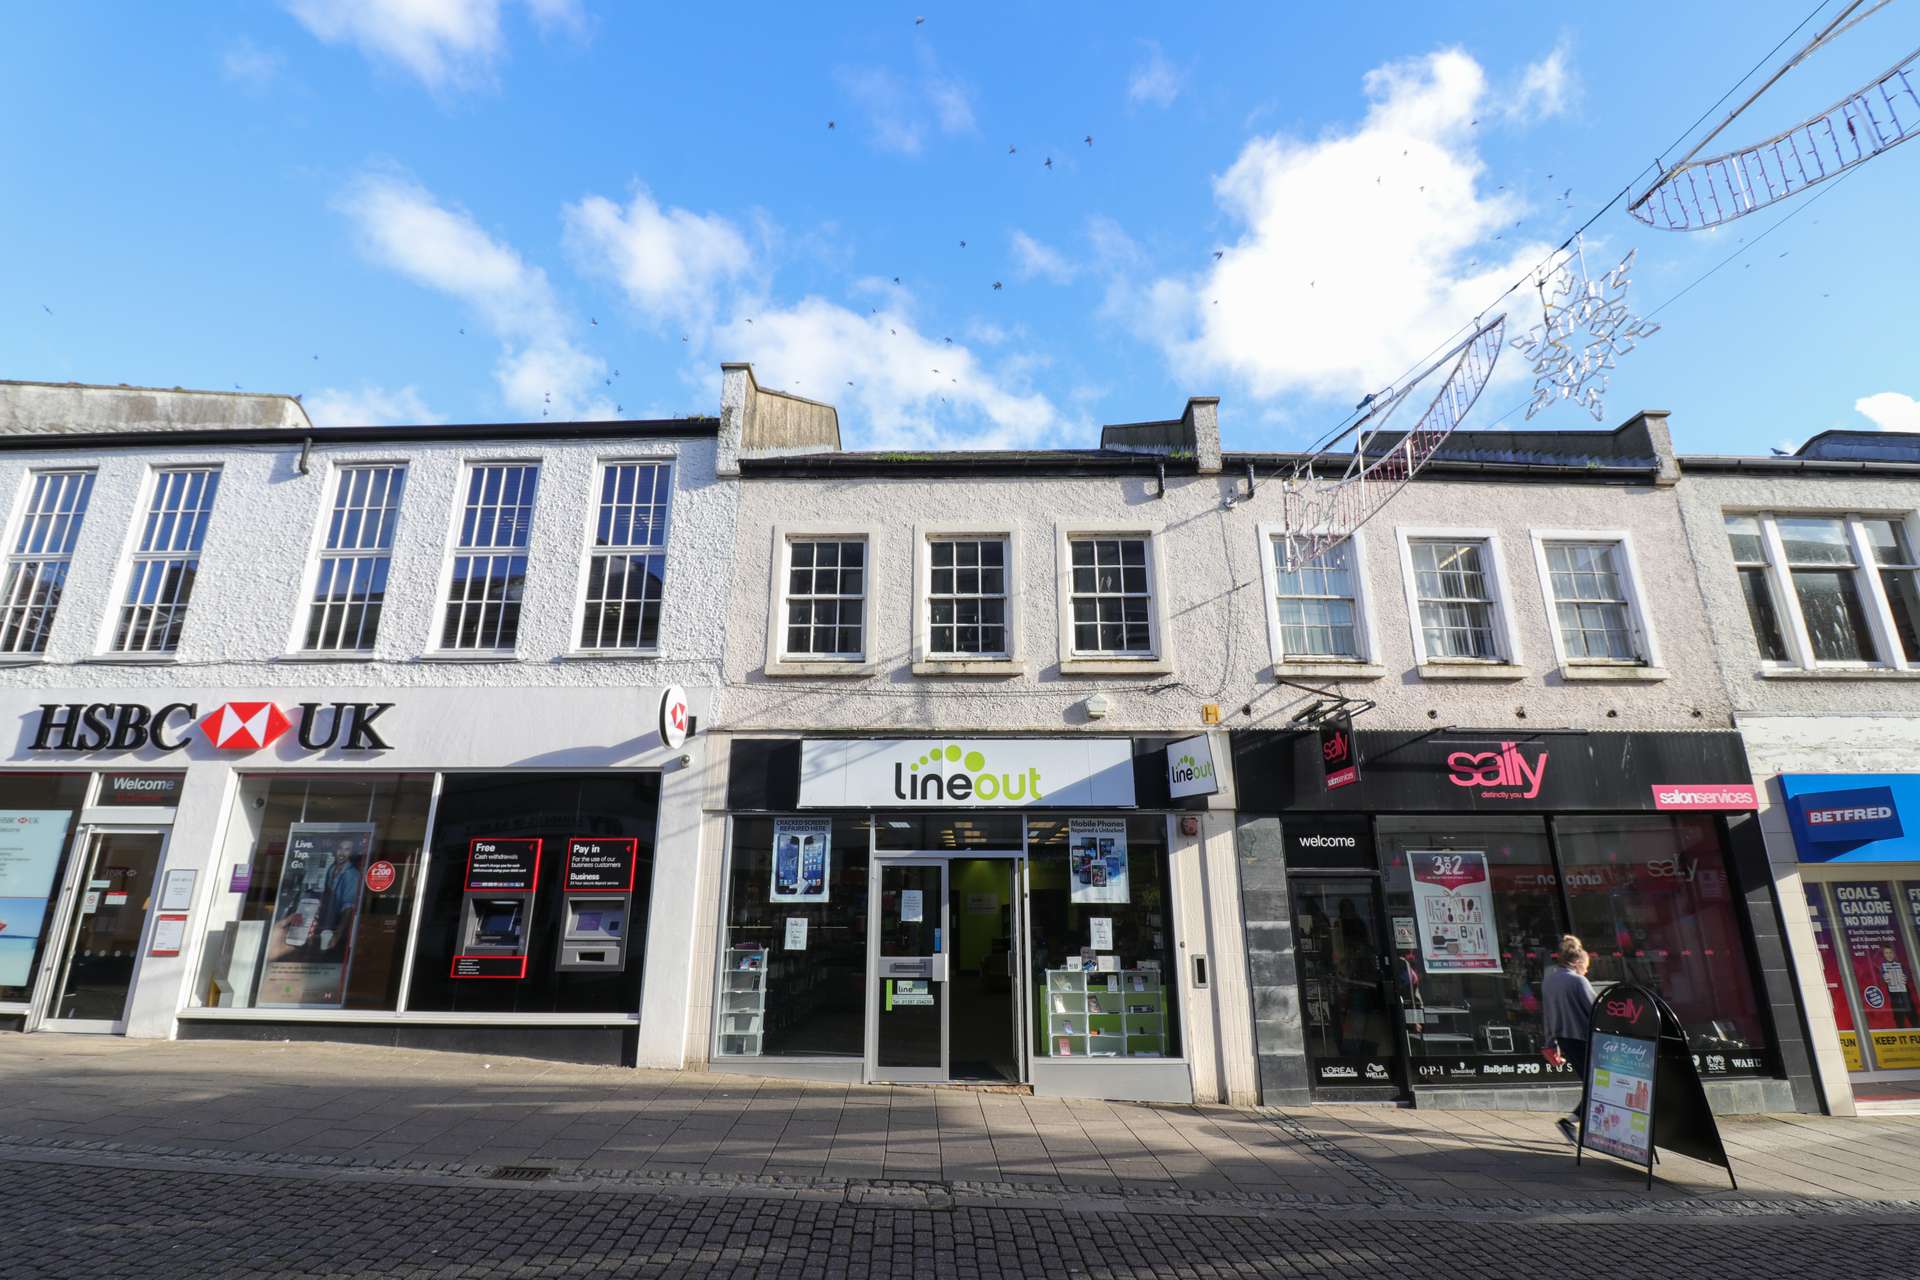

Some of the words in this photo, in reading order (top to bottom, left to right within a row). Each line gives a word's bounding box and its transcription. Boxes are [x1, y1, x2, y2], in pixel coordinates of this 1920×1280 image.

[27, 703, 198, 751] HSBC
[298, 702, 395, 750] UK
[1323, 731, 1348, 761] sally
[1171, 761, 1213, 784] lineout
[1447, 741, 1548, 799] sally
[113, 777, 175, 790] Welcome
[895, 762, 1042, 801] lineout
[1659, 789, 1753, 804] salonservices
[1809, 806, 1892, 824] BETFRED
[476, 842, 496, 852] Free
[1299, 834, 1355, 847] welcome
[573, 844, 589, 855] Pay
[591, 844, 600, 853] in
[1432, 855, 1445, 875] 3
[1452, 855, 1465, 875] 2
[570, 872, 600, 880] Business
[1837, 887, 1880, 900] GOALS
[1841, 901, 1893, 914] GALORE
[1844, 917, 1858, 926] NO
[1860, 916, 1889, 926] DRAW
[1606, 998, 1644, 1024] sally
[1874, 1035, 1896, 1046] KEEP
[1897, 1035, 1907, 1045] IT
[1908, 1035, 1920, 1045] FU
[1602, 1041, 1618, 1053] Get
[1620, 1043, 1647, 1060] Ready
[1732, 1058, 1762, 1068] WAHL
